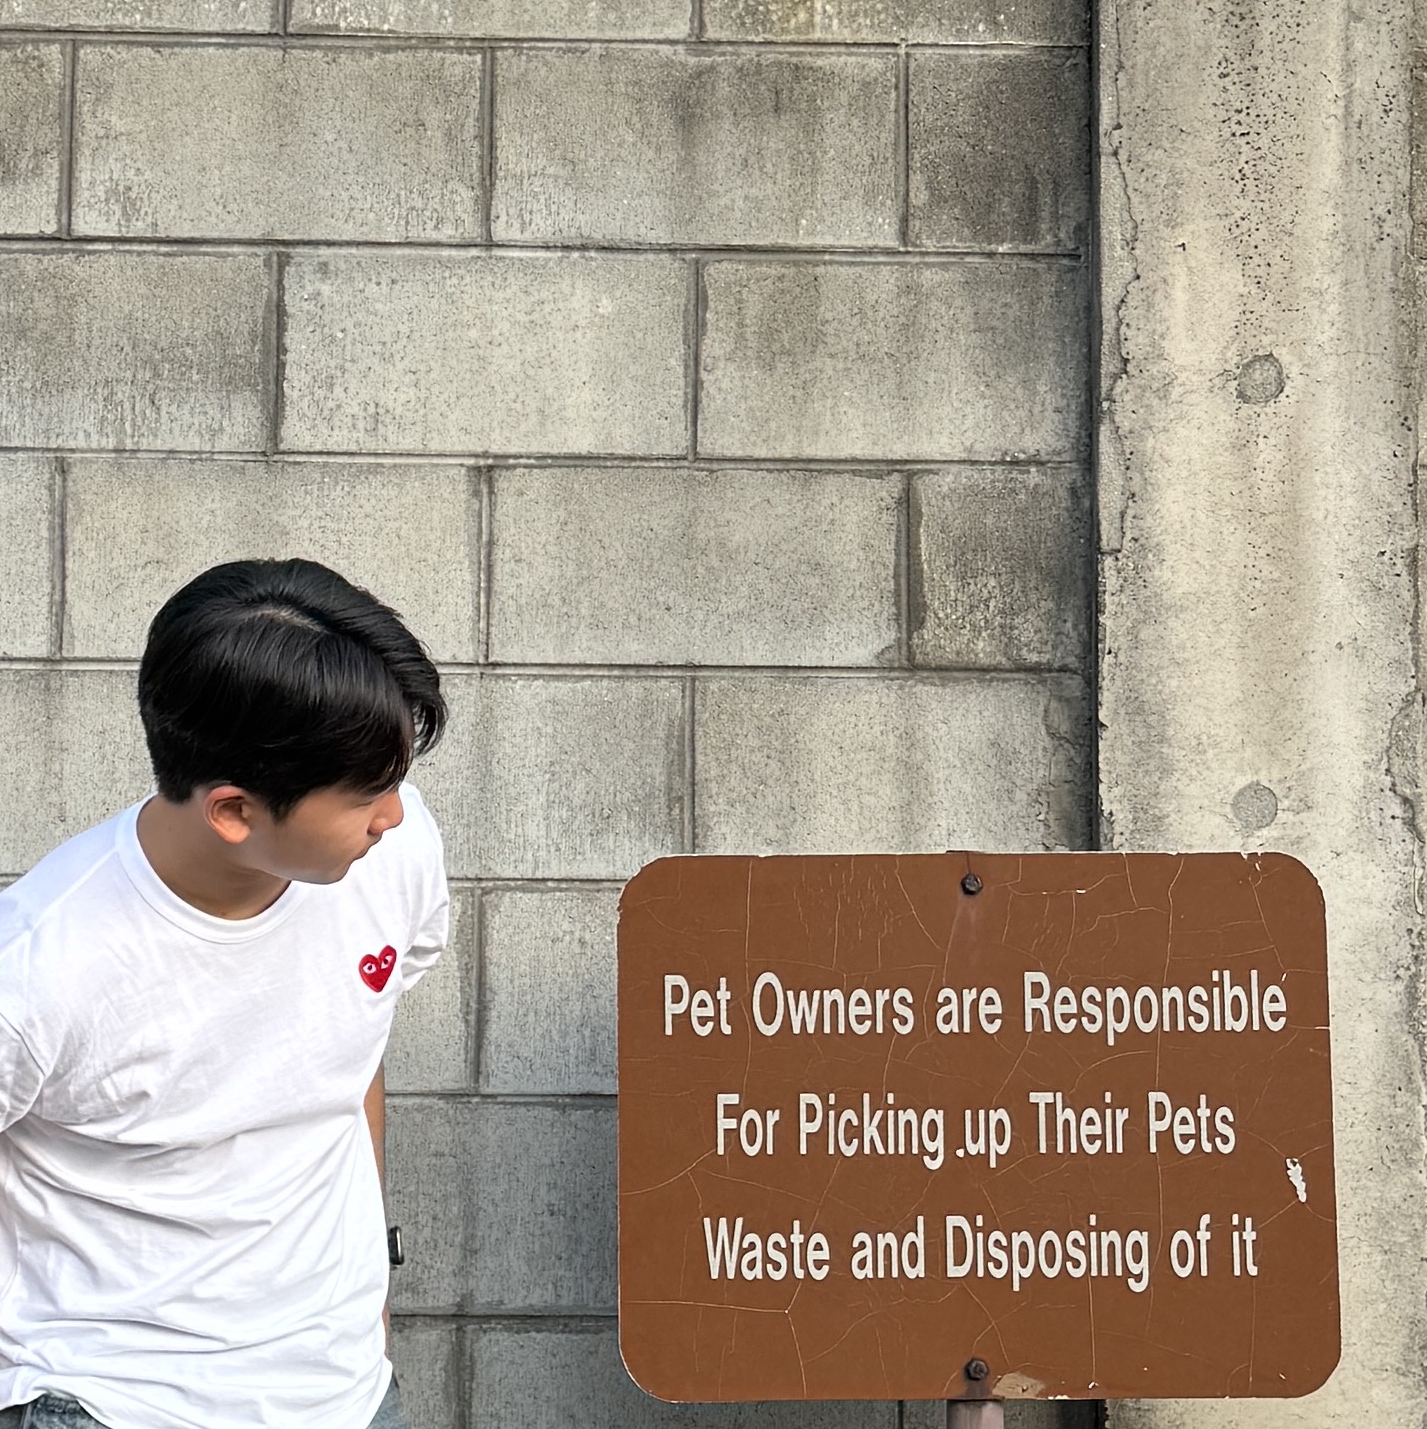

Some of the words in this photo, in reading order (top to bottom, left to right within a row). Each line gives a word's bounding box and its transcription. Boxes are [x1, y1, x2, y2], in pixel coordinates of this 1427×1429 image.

[664, 974, 732, 1037] Pet
[752, 971, 915, 1037] Owners
[936, 987, 1003, 1035] are
[1023, 969, 1287, 1046] Responsible
[716, 1093, 780, 1157] For
[799, 1092, 945, 1171] Picking
[964, 1107, 1012, 1169] up
[1028, 1091, 1129, 1155] Their
[1147, 1091, 1236, 1155] Pets
[703, 1216, 830, 1281] Waste
[851, 1215, 926, 1280] and
[945, 1214, 1150, 1293] Disposing
[1170, 1213, 1212, 1278] of
[1231, 1213, 1259, 1277] it
